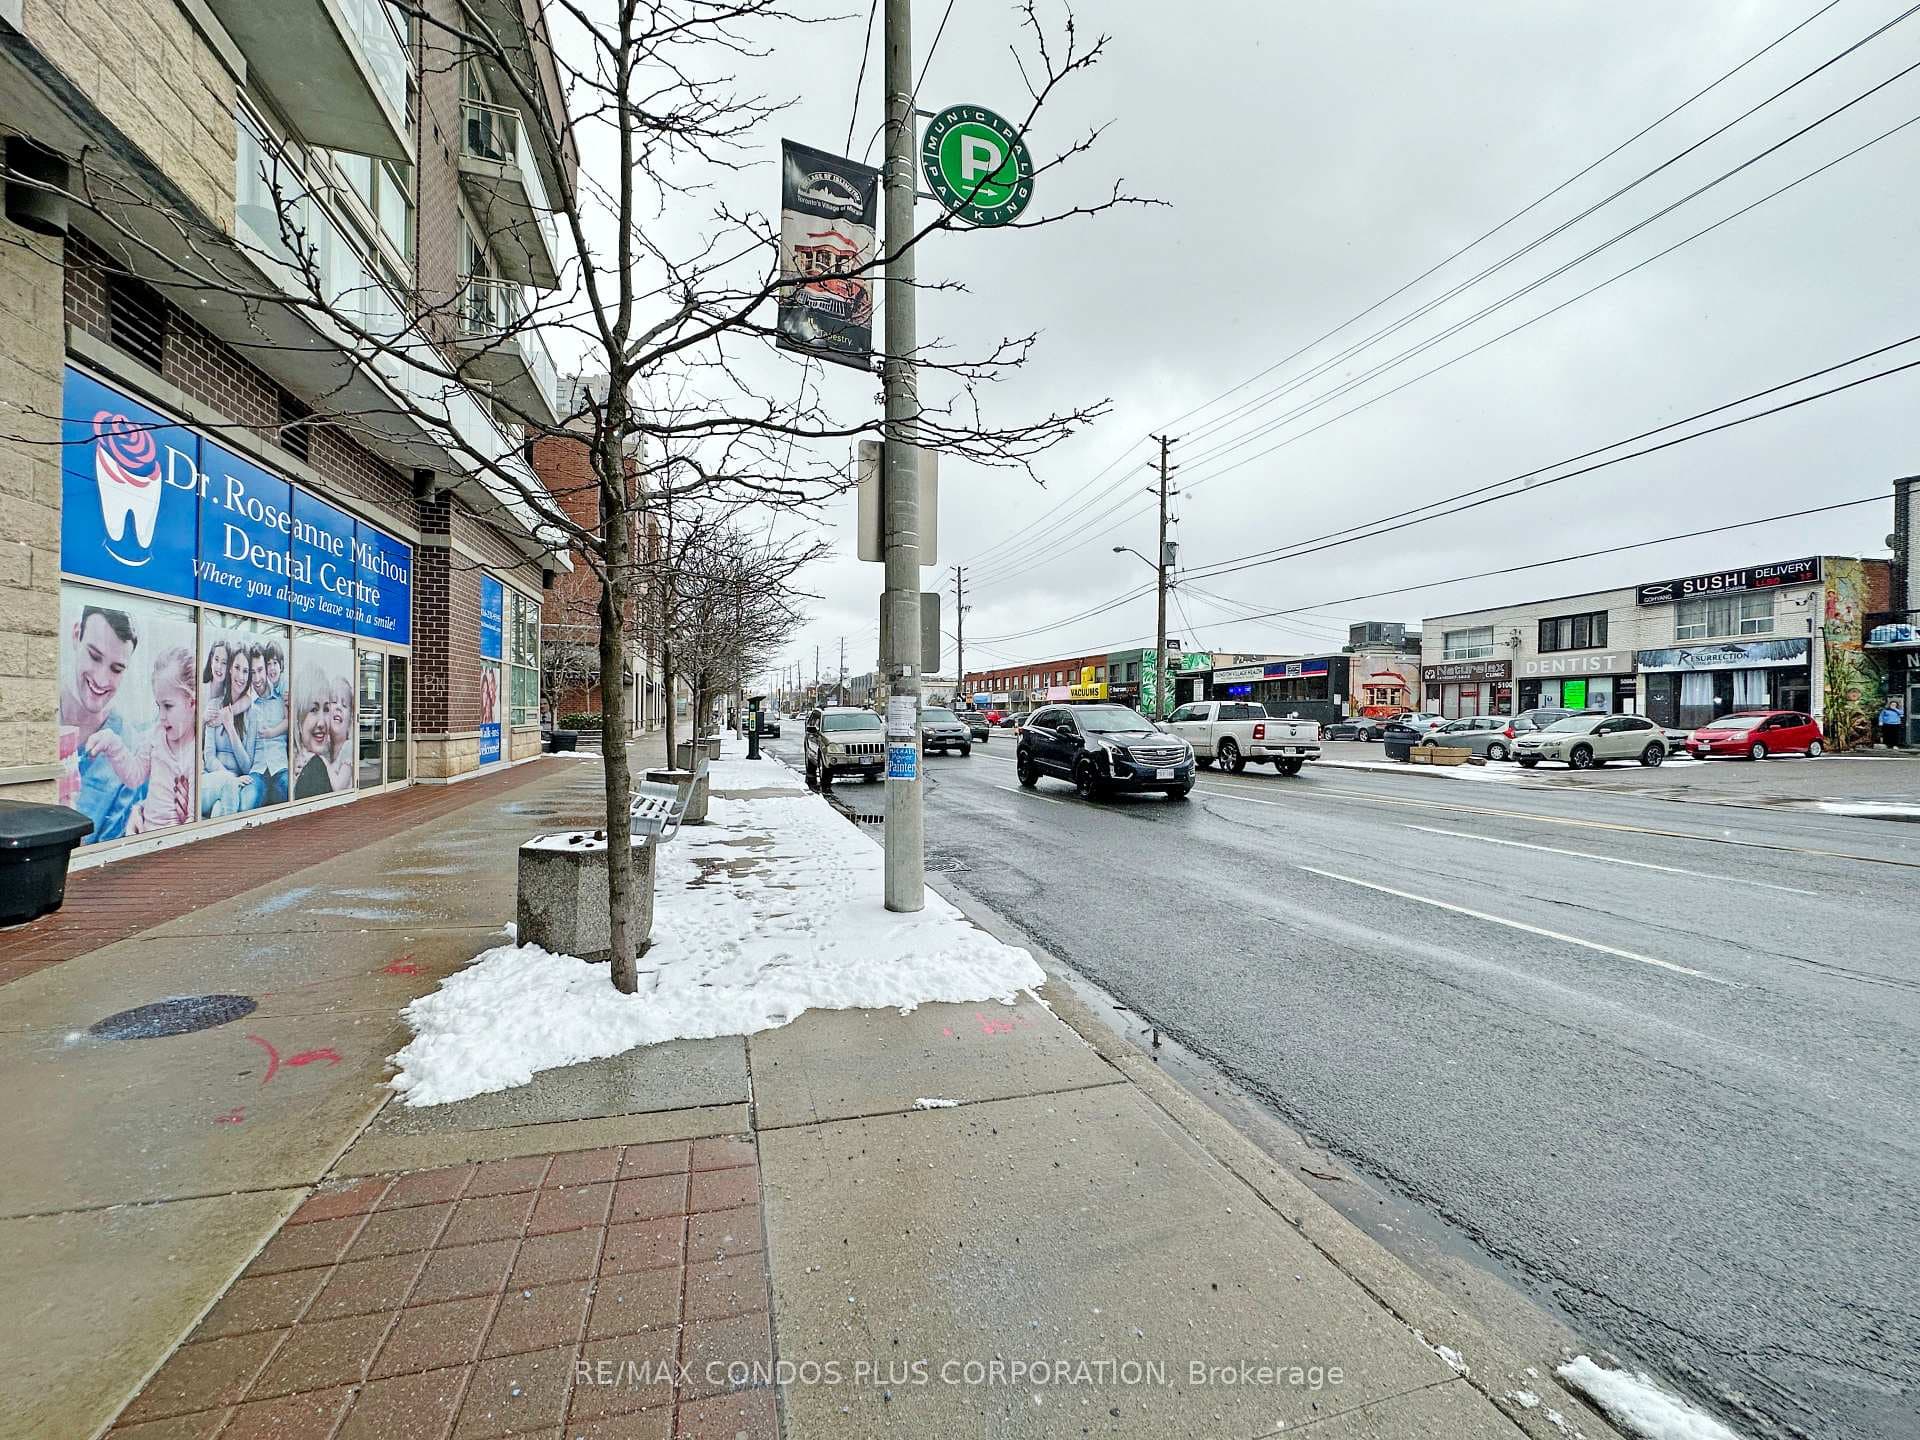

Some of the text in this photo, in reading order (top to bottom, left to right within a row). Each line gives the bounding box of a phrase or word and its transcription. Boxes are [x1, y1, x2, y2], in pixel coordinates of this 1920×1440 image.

[928, 109, 1029, 171] MUNICIPAL
[961, 134, 1002, 180] P
[928, 165, 1028, 220] PARKING
[165, 445, 408, 585] Dr. Roseanne Michou
[223, 523, 381, 607] Dental Centre
[1683, 571, 1746, 593] SUSHI
[1755, 561, 1812, 579] DELIVERY
[192, 558, 243, 589] Where
[247, 579, 272, 598] you
[277, 585, 315, 613] always
[319, 596, 343, 617] leave
[366, 615, 372, 624] a
[373, 613, 397, 631] smile!
[1526, 655, 1617, 674] DENTIST
[1070, 687, 1099, 697] VACUUMS
[889, 760, 915, 773] Painter
